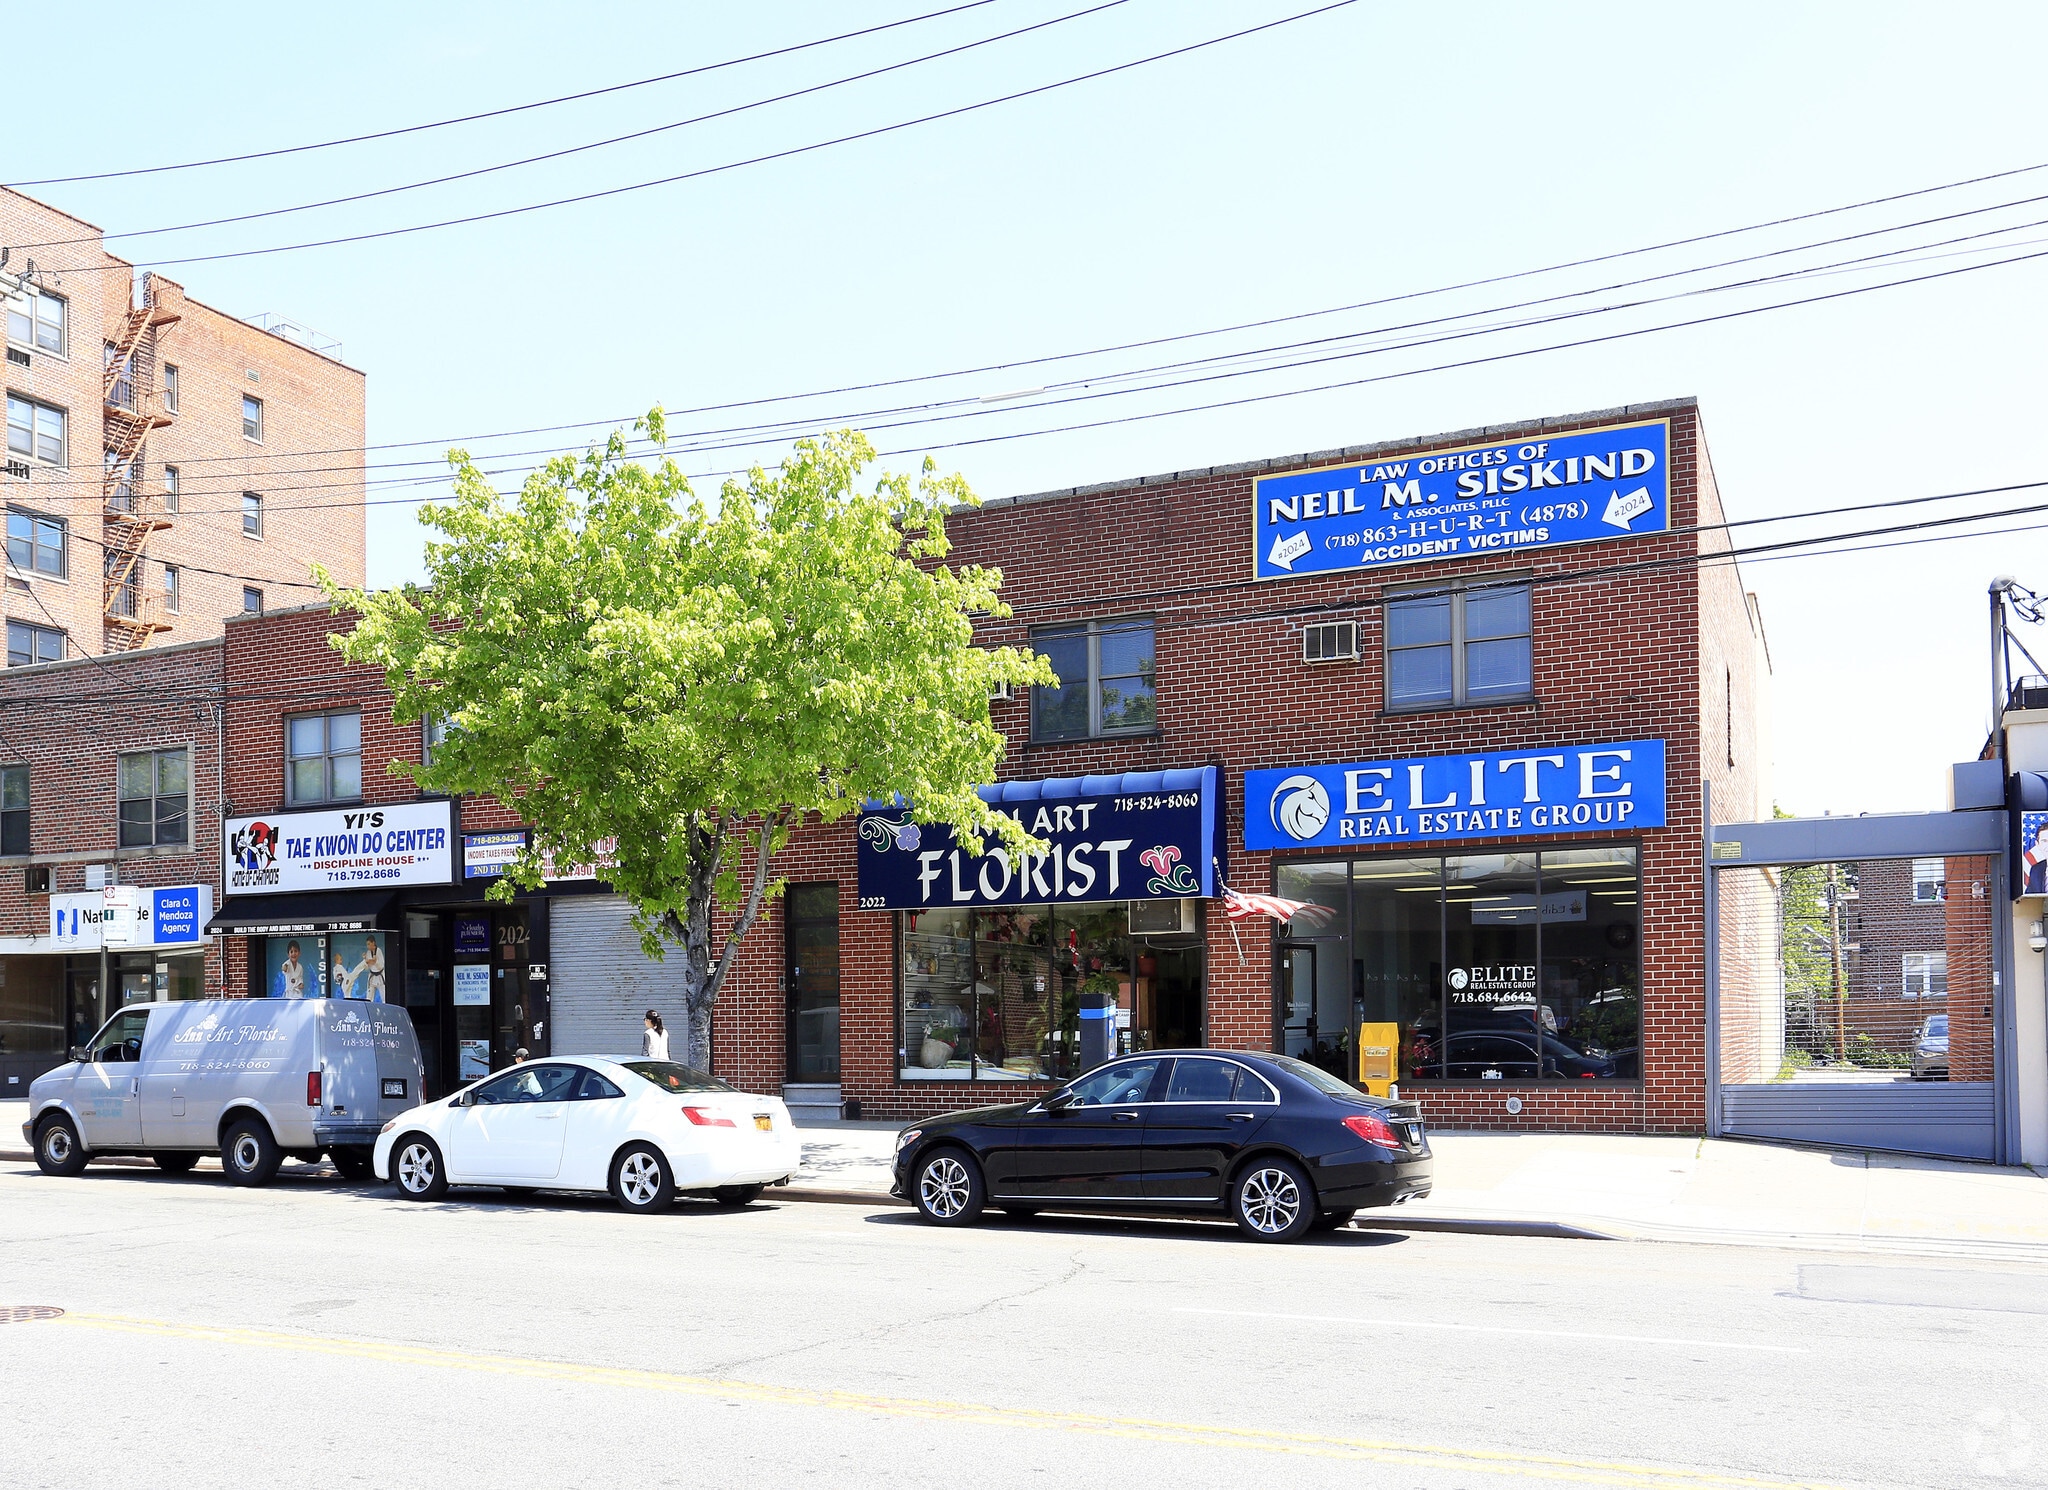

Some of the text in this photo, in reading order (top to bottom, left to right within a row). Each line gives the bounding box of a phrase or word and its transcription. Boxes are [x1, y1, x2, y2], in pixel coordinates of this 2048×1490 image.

[1359, 442, 1549, 484] LAW OFFICES OF
[1269, 448, 1656, 525] NEIL M. SISKIND
[1393, 512, 1402, 521] &
[1482, 498, 1511, 510] PLLC
[1614, 495, 1646, 517] #2024
[1325, 499, 1589, 550] (718) 863-H-U-R-T (4878)
[1278, 539, 1305, 559] #2024
[1361, 527, 1549, 563] ACCIDENT VICTIMS
[1344, 749, 1633, 814] ELITE
[1114, 792, 1198, 813] 718-824-8060
[343, 812, 385, 830] YI'S
[1031, 803, 1098, 834] ART
[1339, 801, 1635, 838] REAL ESTATE GROUP
[286, 837, 311, 858] TAE
[315, 833, 358, 857] KWON
[362, 832, 383, 854] DO
[386, 828, 445, 851] CENTER
[472, 835, 519, 845] 718-829-9420
[468, 850, 485, 860] INCOME
[486, 848, 500, 858] TAXES
[314, 856, 415, 870] DISCIPLINE HOUSE
[473, 866, 489, 875] 2ND
[917, 839, 1133, 902] FLORIST
[327, 868, 401, 882] 718.792.8686
[161, 898, 191, 909] Clara O.
[860, 896, 886, 908] 2022
[159, 911, 193, 921] Mendoza
[162, 924, 191, 935] Agency
[291, 924, 315, 932] TOGETHER
[339, 922, 348, 930] 792
[1471, 966, 1536, 982] ELITE
[1470, 981, 1536, 990] REAL ESTATE GROUP
[1452, 991, 1532, 1003] 718.684.6642
[174, 1026, 203, 1043] Ann
[207, 1025, 234, 1042] Art
[234, 1024, 279, 1046] Florist
[330, 1020, 398, 1036] Ann Art Florist
[180, 1061, 270, 1070] 718-824-8060
